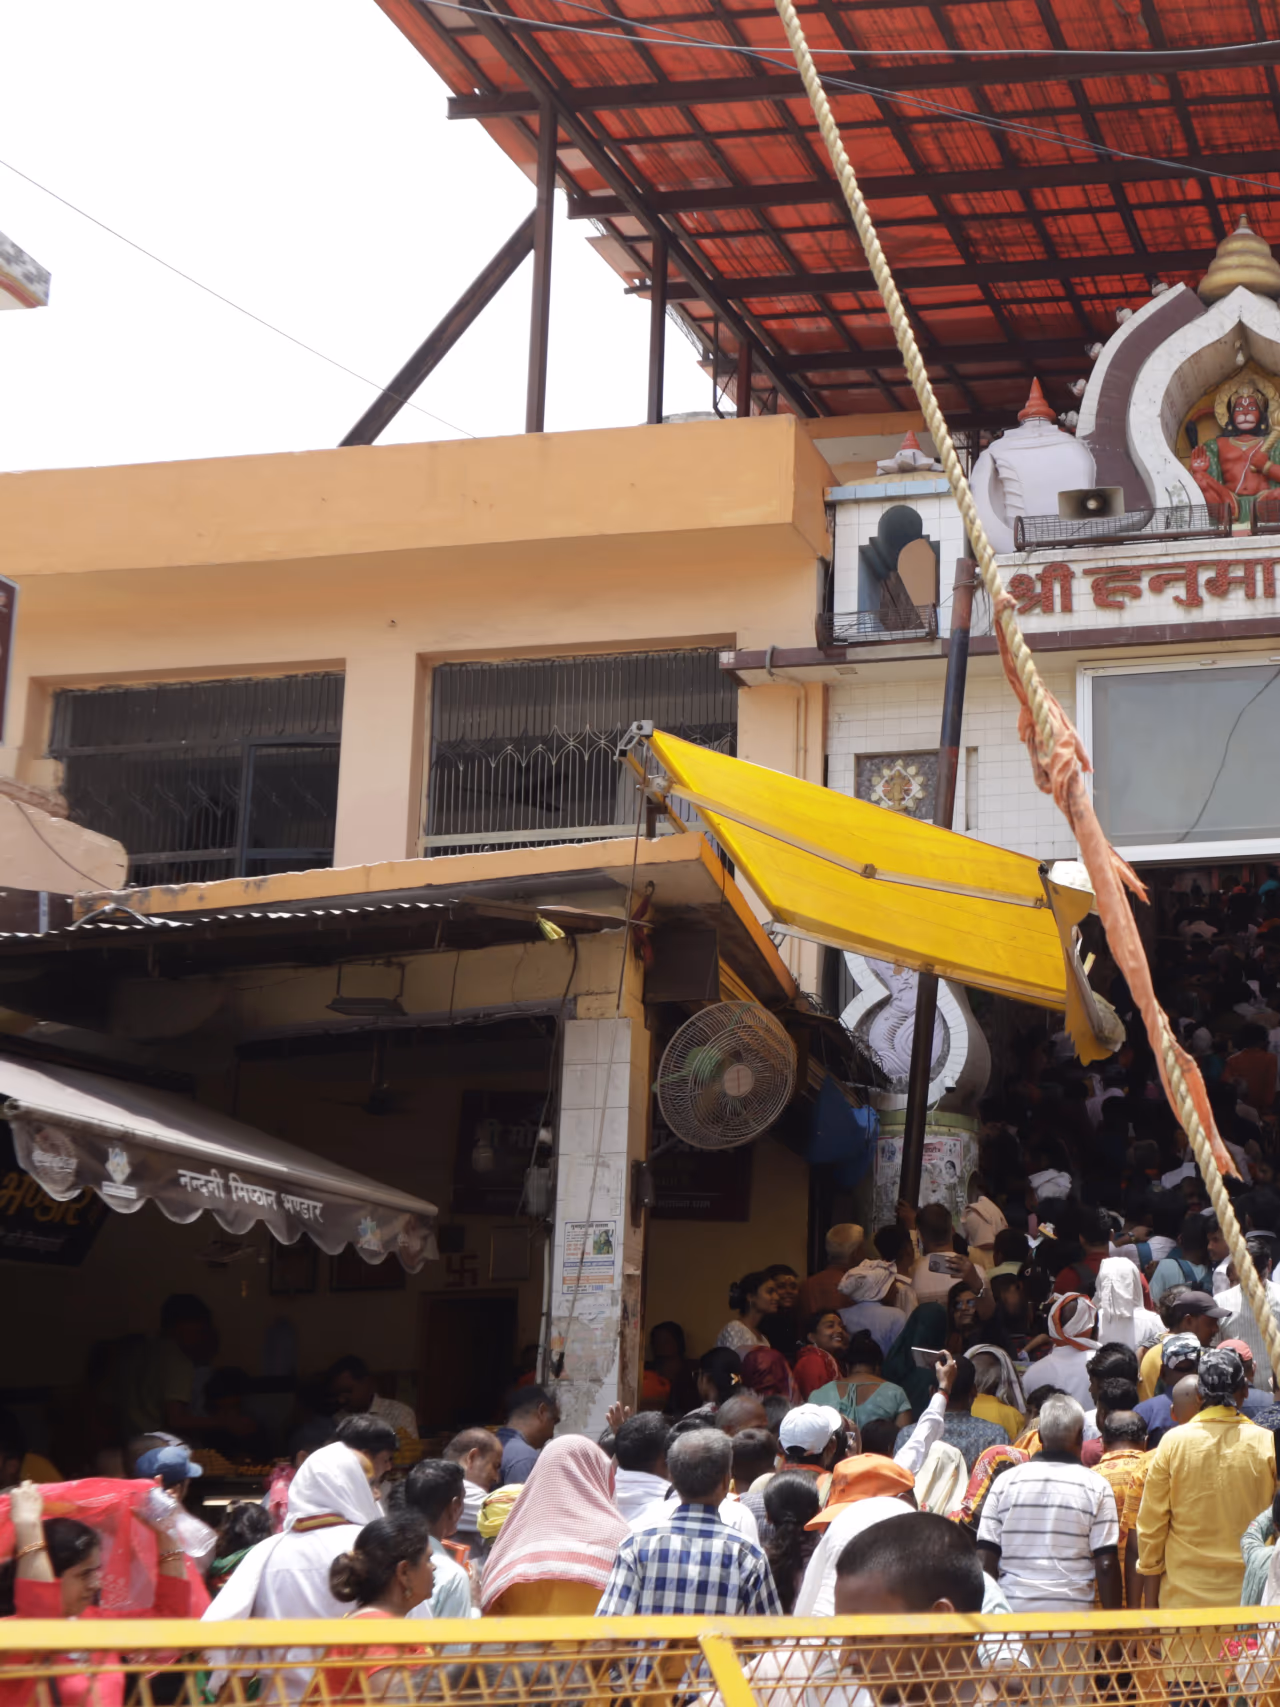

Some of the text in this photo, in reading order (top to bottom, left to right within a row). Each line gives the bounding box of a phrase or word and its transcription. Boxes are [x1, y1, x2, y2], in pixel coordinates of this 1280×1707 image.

[1008, 562, 1075, 614] श्री
[177, 1168, 226, 1200] नन्दनी
[281, 1192, 325, 1224] भण्डार
